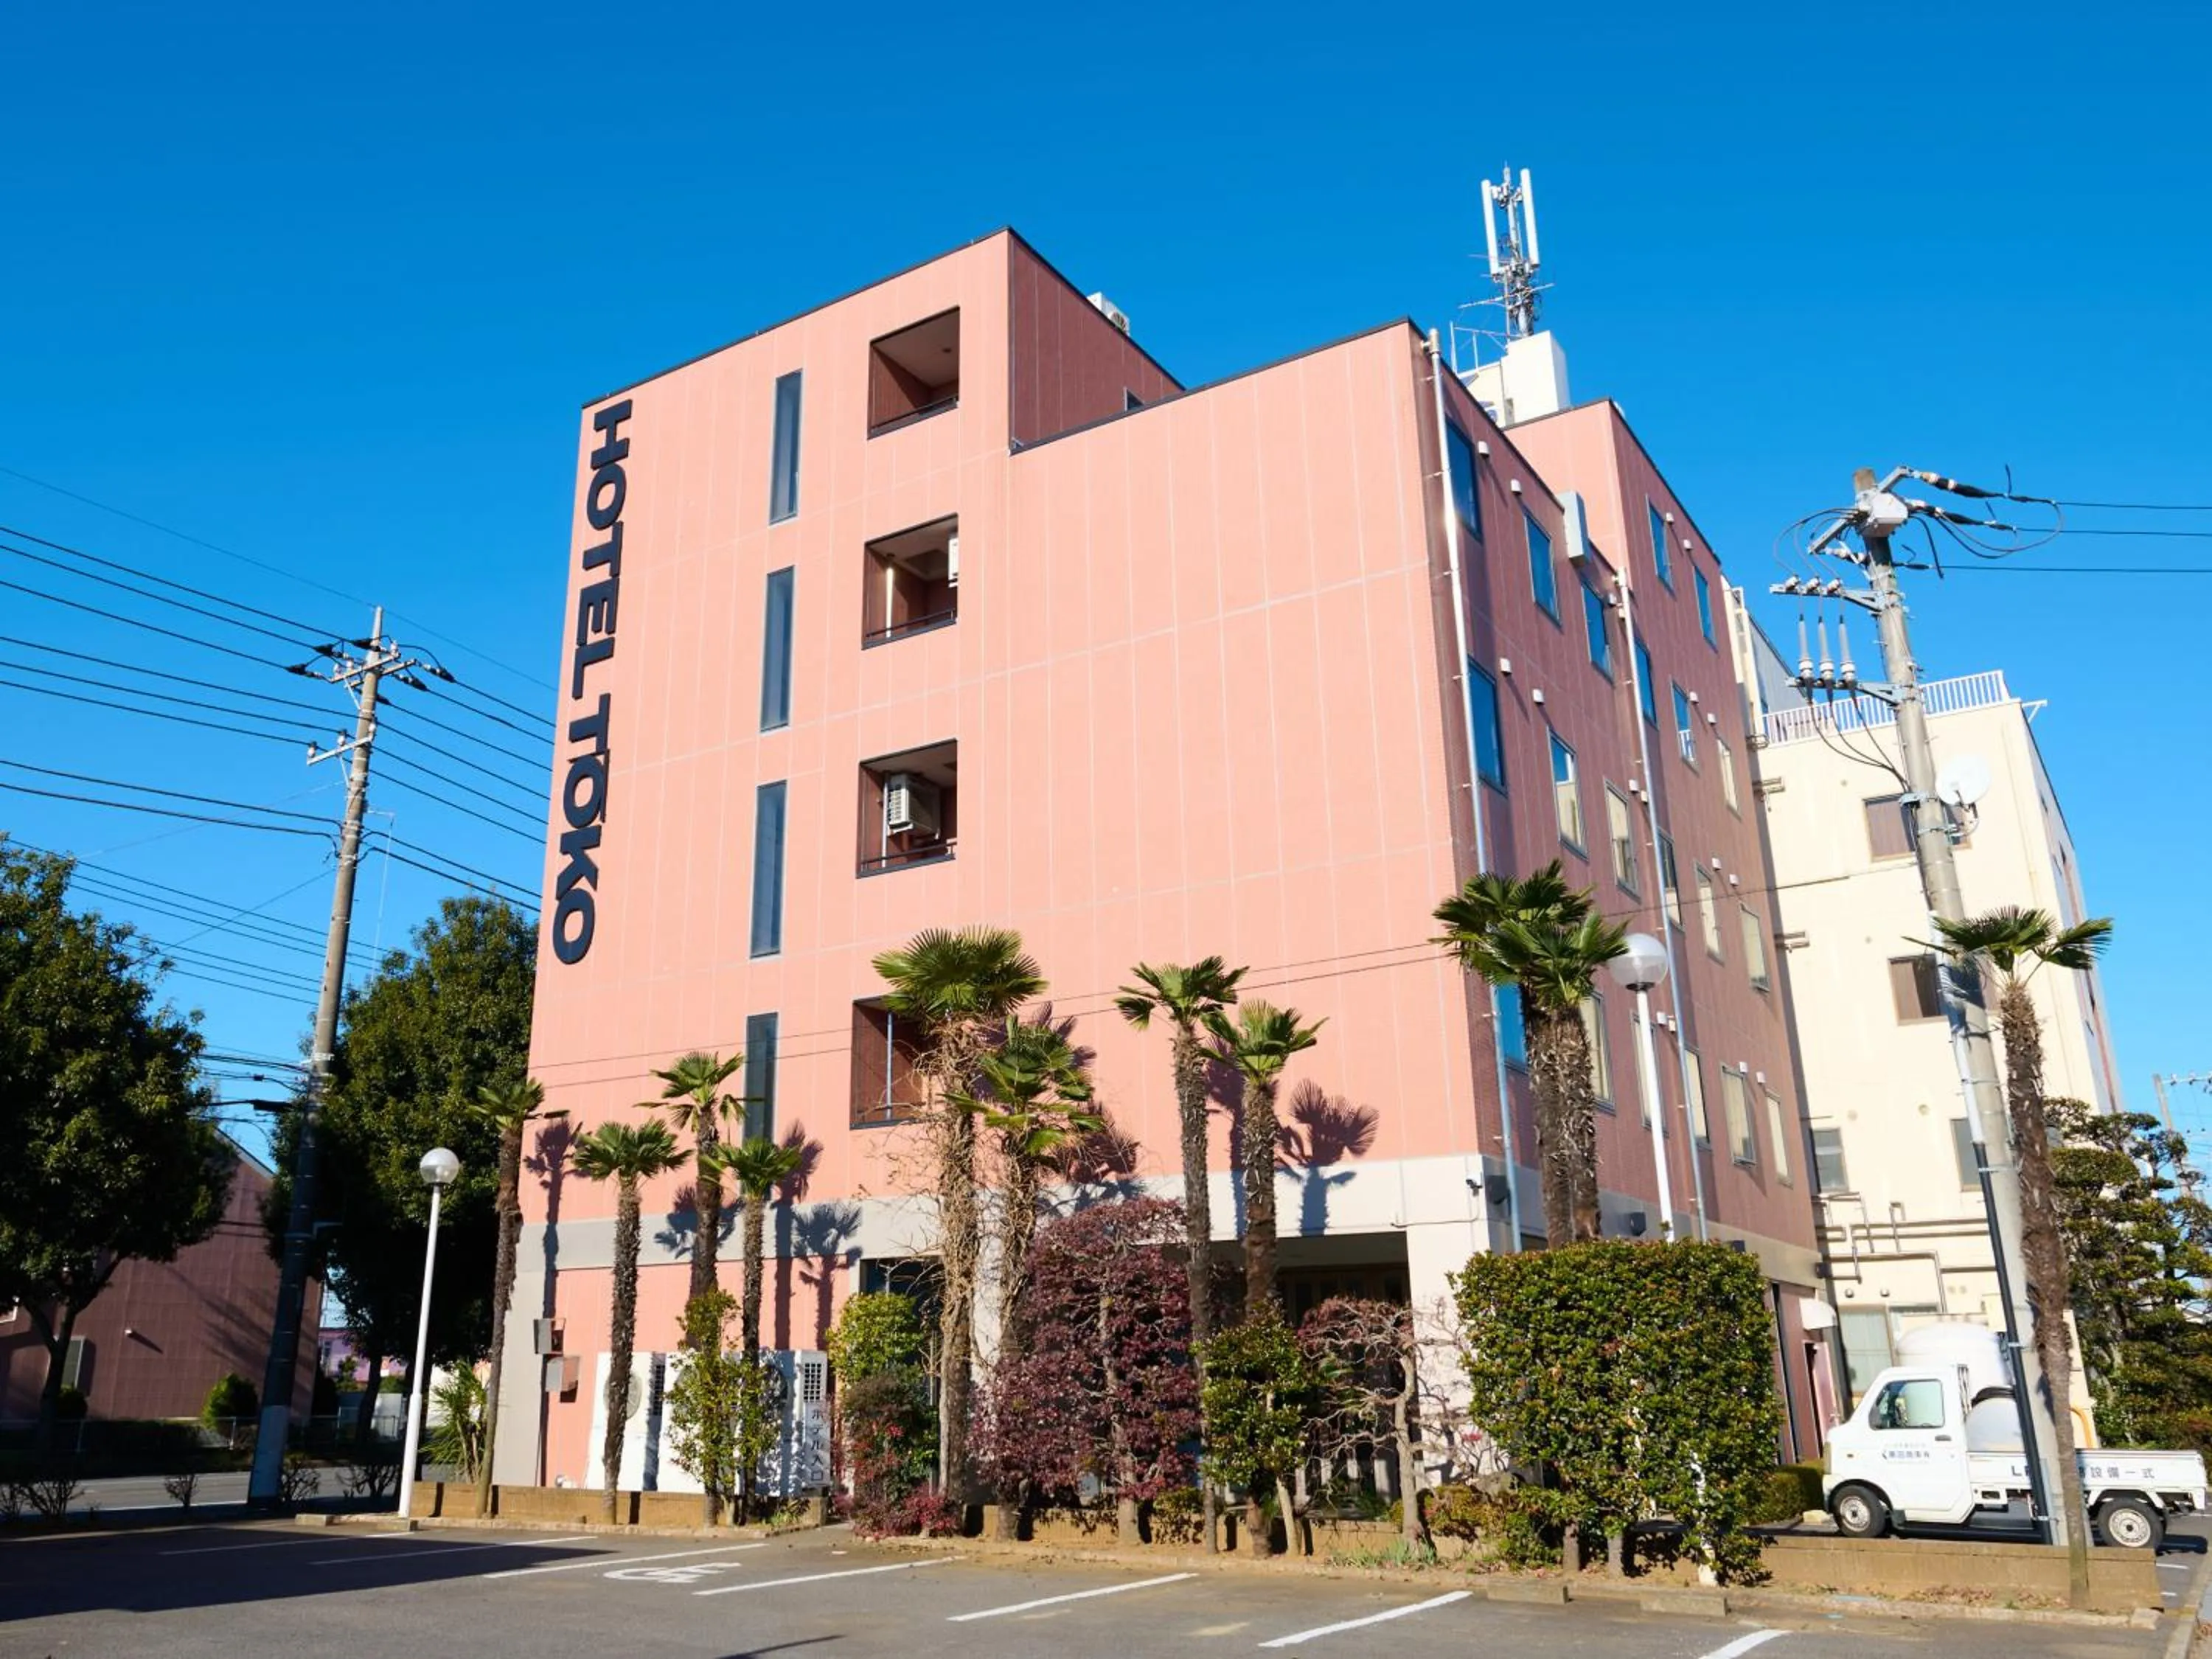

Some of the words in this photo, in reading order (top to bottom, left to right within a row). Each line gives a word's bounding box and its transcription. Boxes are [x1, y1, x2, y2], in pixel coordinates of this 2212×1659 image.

[572, 400, 632, 700] HOTEL
[811, 1409, 824, 1481] ホテル入口
